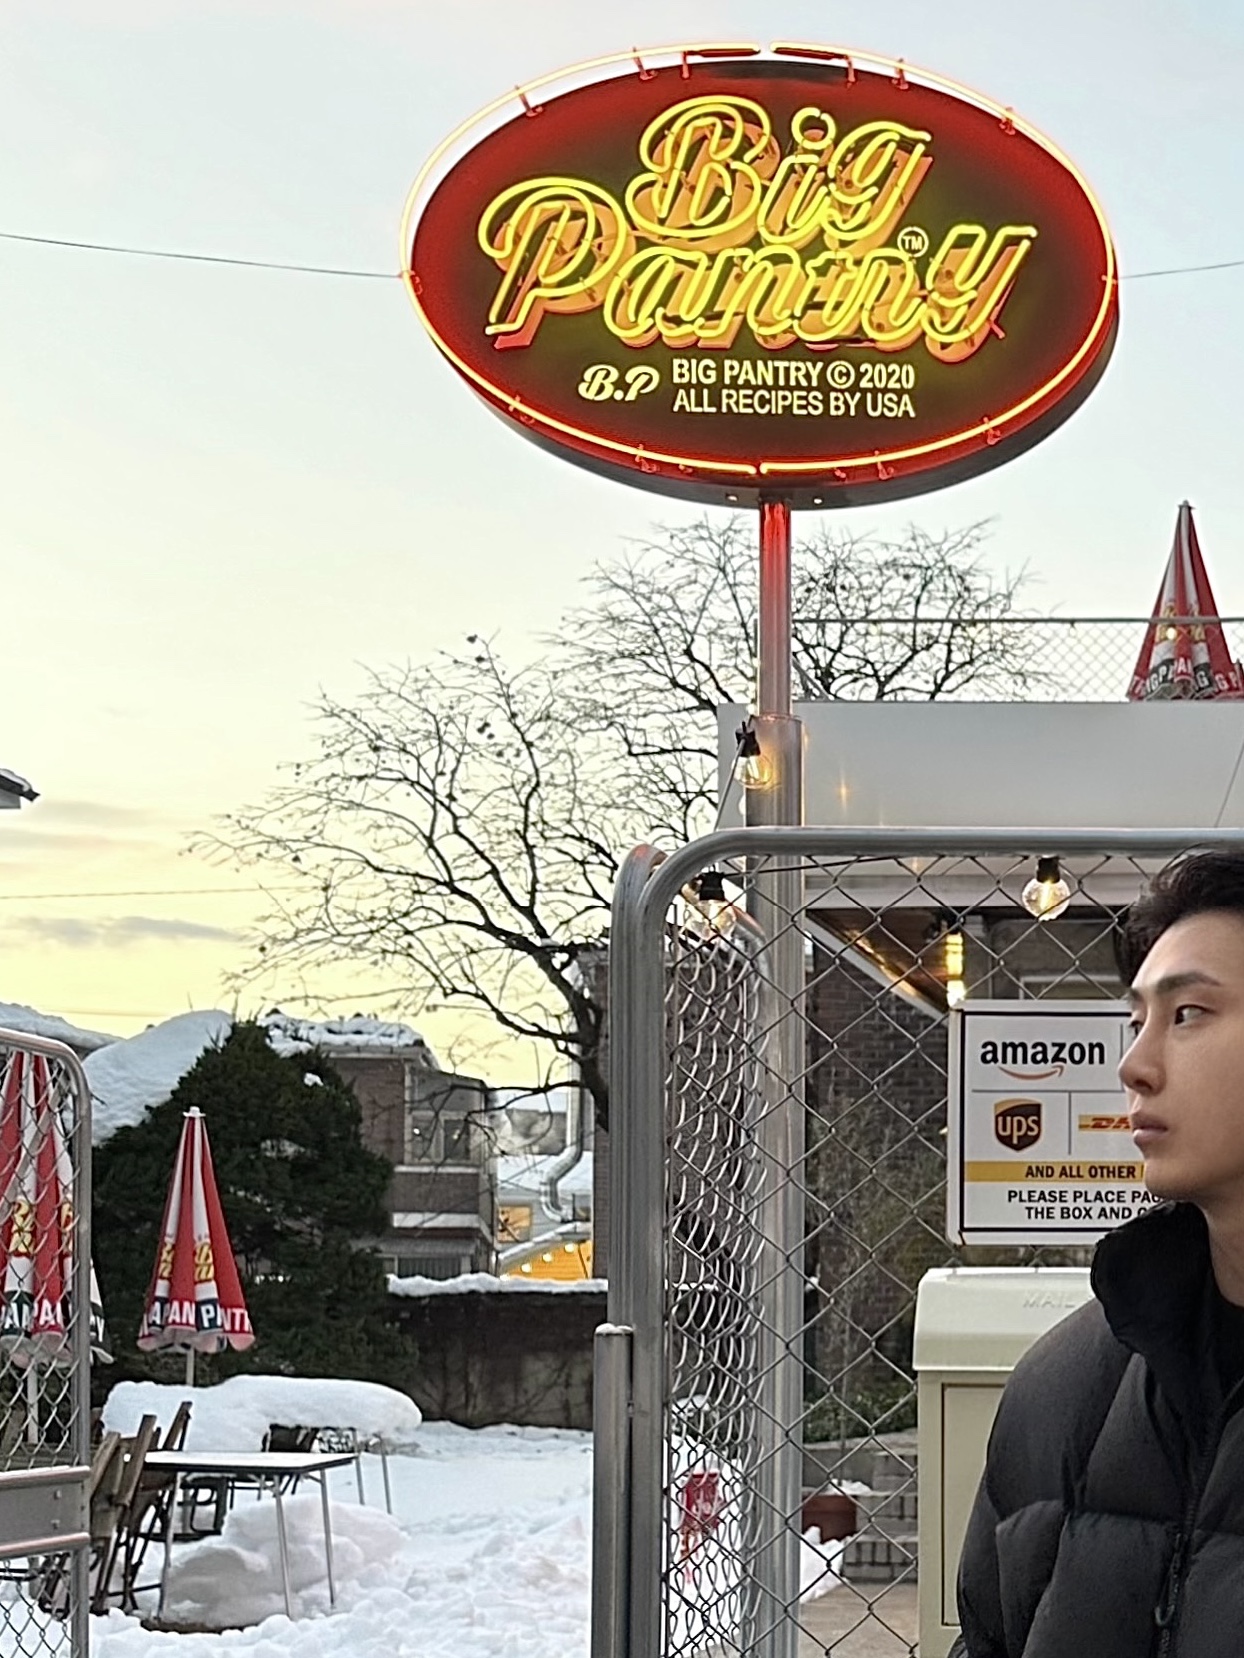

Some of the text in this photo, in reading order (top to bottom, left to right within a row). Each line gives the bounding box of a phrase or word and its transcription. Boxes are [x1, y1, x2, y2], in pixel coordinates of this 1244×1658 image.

[625, 95, 932, 252] Big
[477, 176, 1038, 358] Pantry
[672, 358, 717, 384] BIG
[723, 360, 823, 387] PANTRY
[859, 363, 915, 389] 2020
[672, 389, 916, 418] ALL RECIPES BY USA
[980, 1040, 1105, 1065] amazon
[997, 1115, 1039, 1145] ups
[1025, 1166, 1054, 1179] AND
[1058, 1166, 1084, 1179] ALL
[1088, 1165, 1136, 1179] OTHER
[1008, 1190, 1067, 1204] PLEASE
[1073, 1190, 1127, 1203] PLACE
[1025, 1207, 1055, 1220] THE
[1060, 1207, 1092, 1220] BOX
[1097, 1206, 1132, 1220] AND
